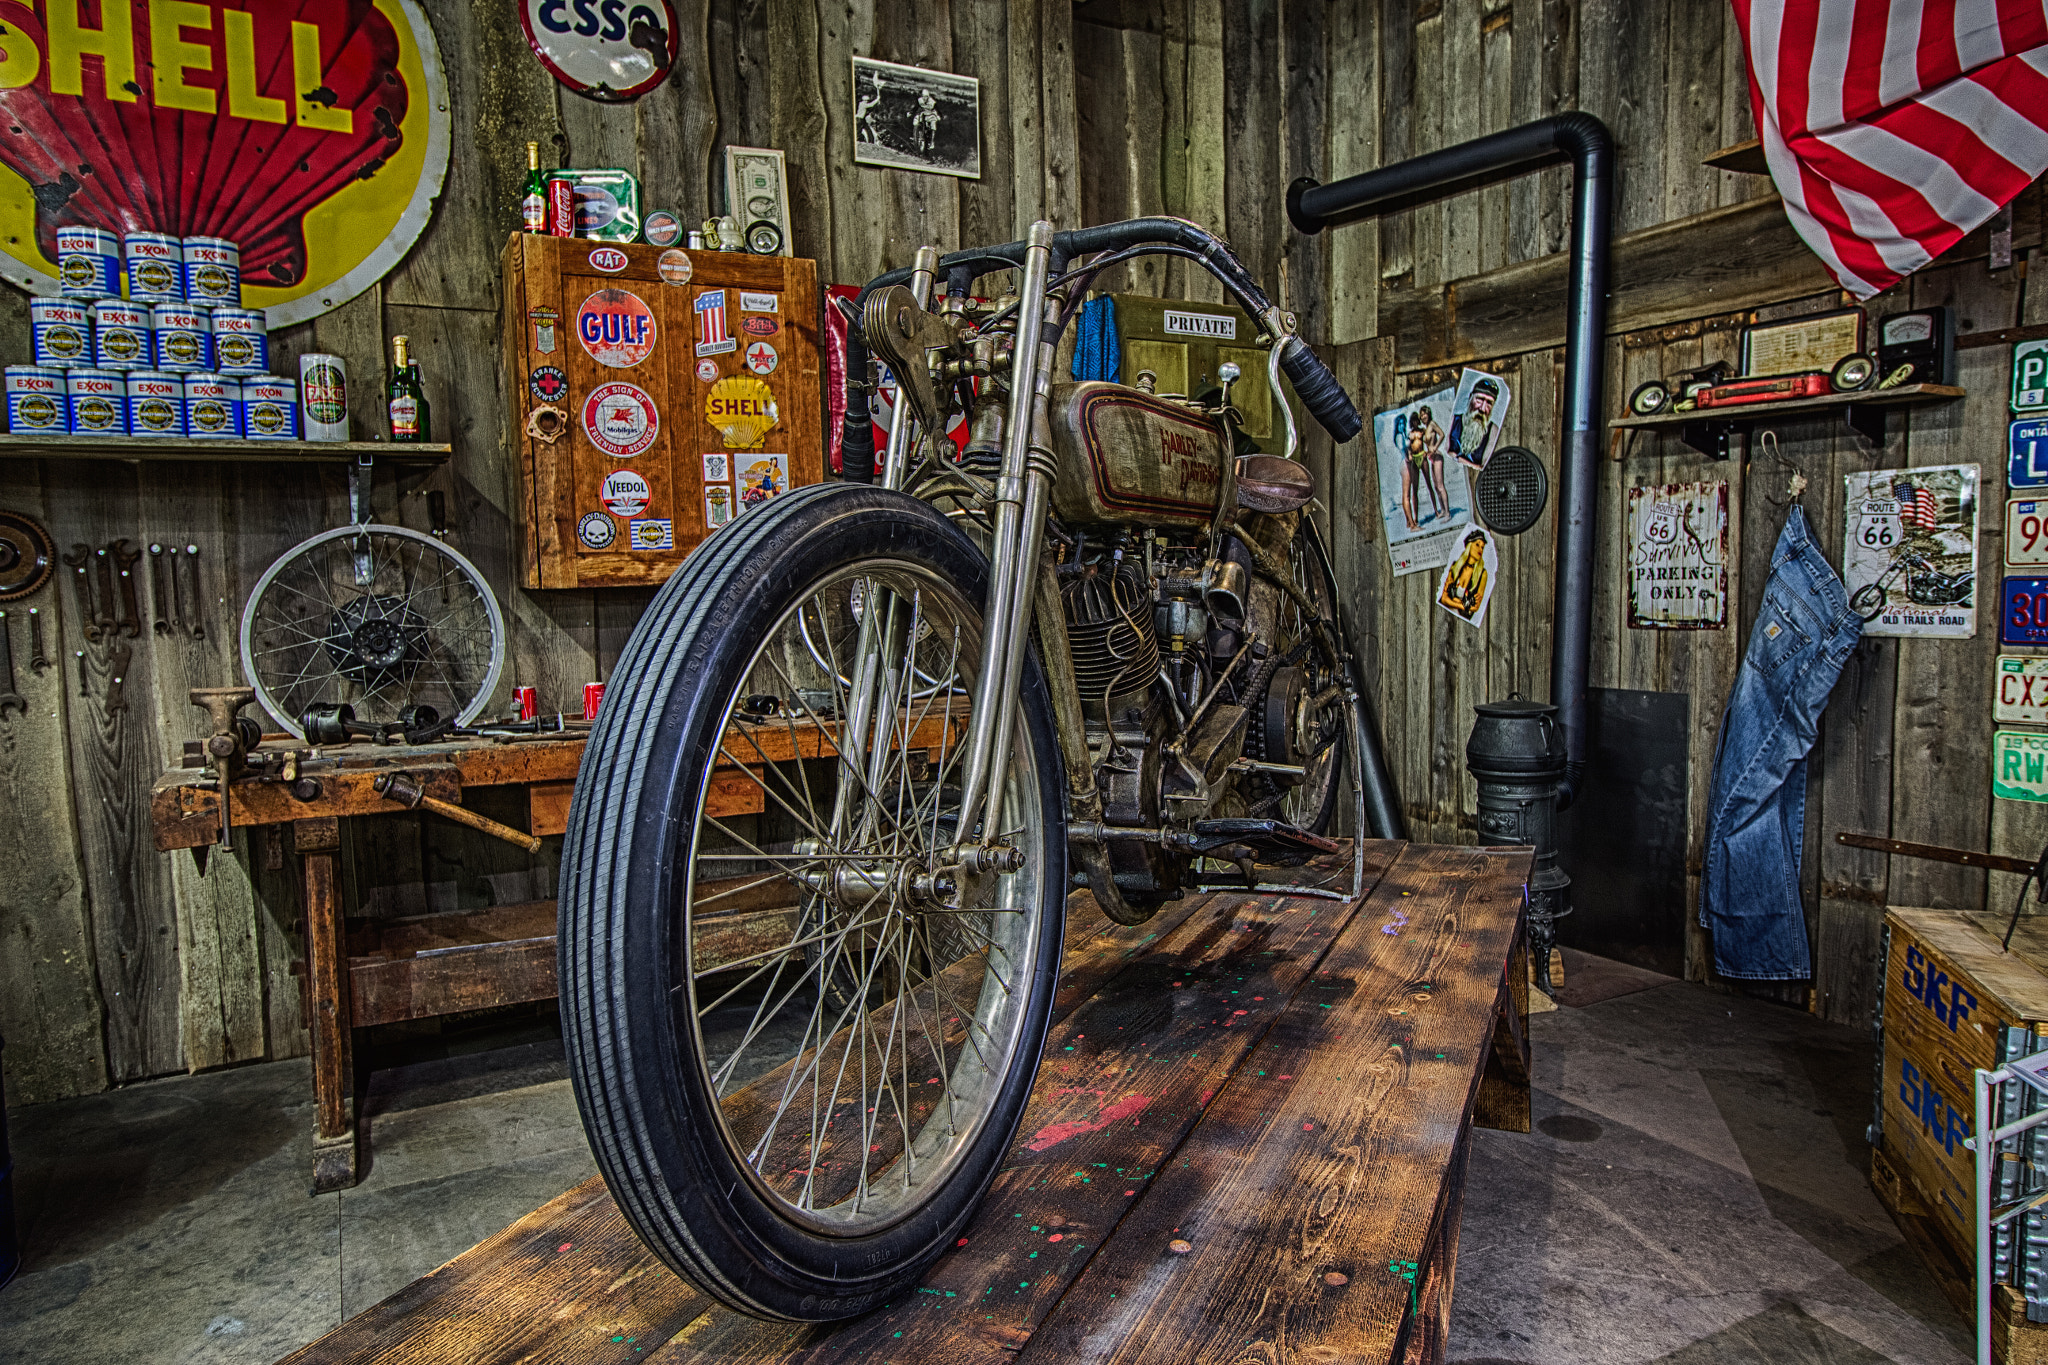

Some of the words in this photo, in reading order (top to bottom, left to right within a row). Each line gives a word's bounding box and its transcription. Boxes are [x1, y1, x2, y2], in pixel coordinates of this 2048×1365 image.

[577, 216, 598, 225] LINES
[62, 238, 94, 251] EXXON
[135, 245, 170, 257] EXXON
[194, 249, 228, 262] EXXON
[595, 252, 621, 268] RAT
[45, 309, 82, 322] EXXON
[102, 312, 139, 324] EXXON
[165, 315, 199, 328] EXXON
[218, 320, 252, 332] EXXON
[581, 312, 650, 346] GULF
[1168, 315, 1232, 335] PRIVATE!
[533, 367, 564, 379] KRANKE
[2022, 358, 2048, 390] P
[16, 378, 54, 391] EXXON
[76, 381, 113, 393] EXXON
[138, 383, 173, 395] EXXON
[193, 385, 224, 397] EXXON
[255, 387, 283, 399] EXXON
[531, 382, 568, 402] SCHWESTER
[593, 388, 610, 402] THE
[612, 386, 633, 395] SIGN
[636, 393, 647, 403] OF
[2028, 393, 2036, 403] 5
[606, 426, 638, 435] Mobilgas
[589, 425, 623, 454] FRIENDLY
[627, 426, 655, 453] SERVICE
[608, 480, 646, 496] VEEDOL
[1655, 503, 1675, 514] ROUTE
[1866, 503, 1895, 512] ROUTE
[1650, 522, 1669, 539] 66
[1864, 526, 1893, 545] 66
[2021, 516, 2048, 552] 9
[1636, 566, 1714, 581] PARKING
[1650, 586, 1697, 600] ONLY
[1881, 604, 1949, 616] National
[1882, 616, 1899, 625] OLD
[1903, 616, 1935, 625] TRAILS
[1938, 616, 1965, 626] ROAD
[1903, 944, 1978, 1034] SKF
[1900, 1057, 1970, 1158] SKF
